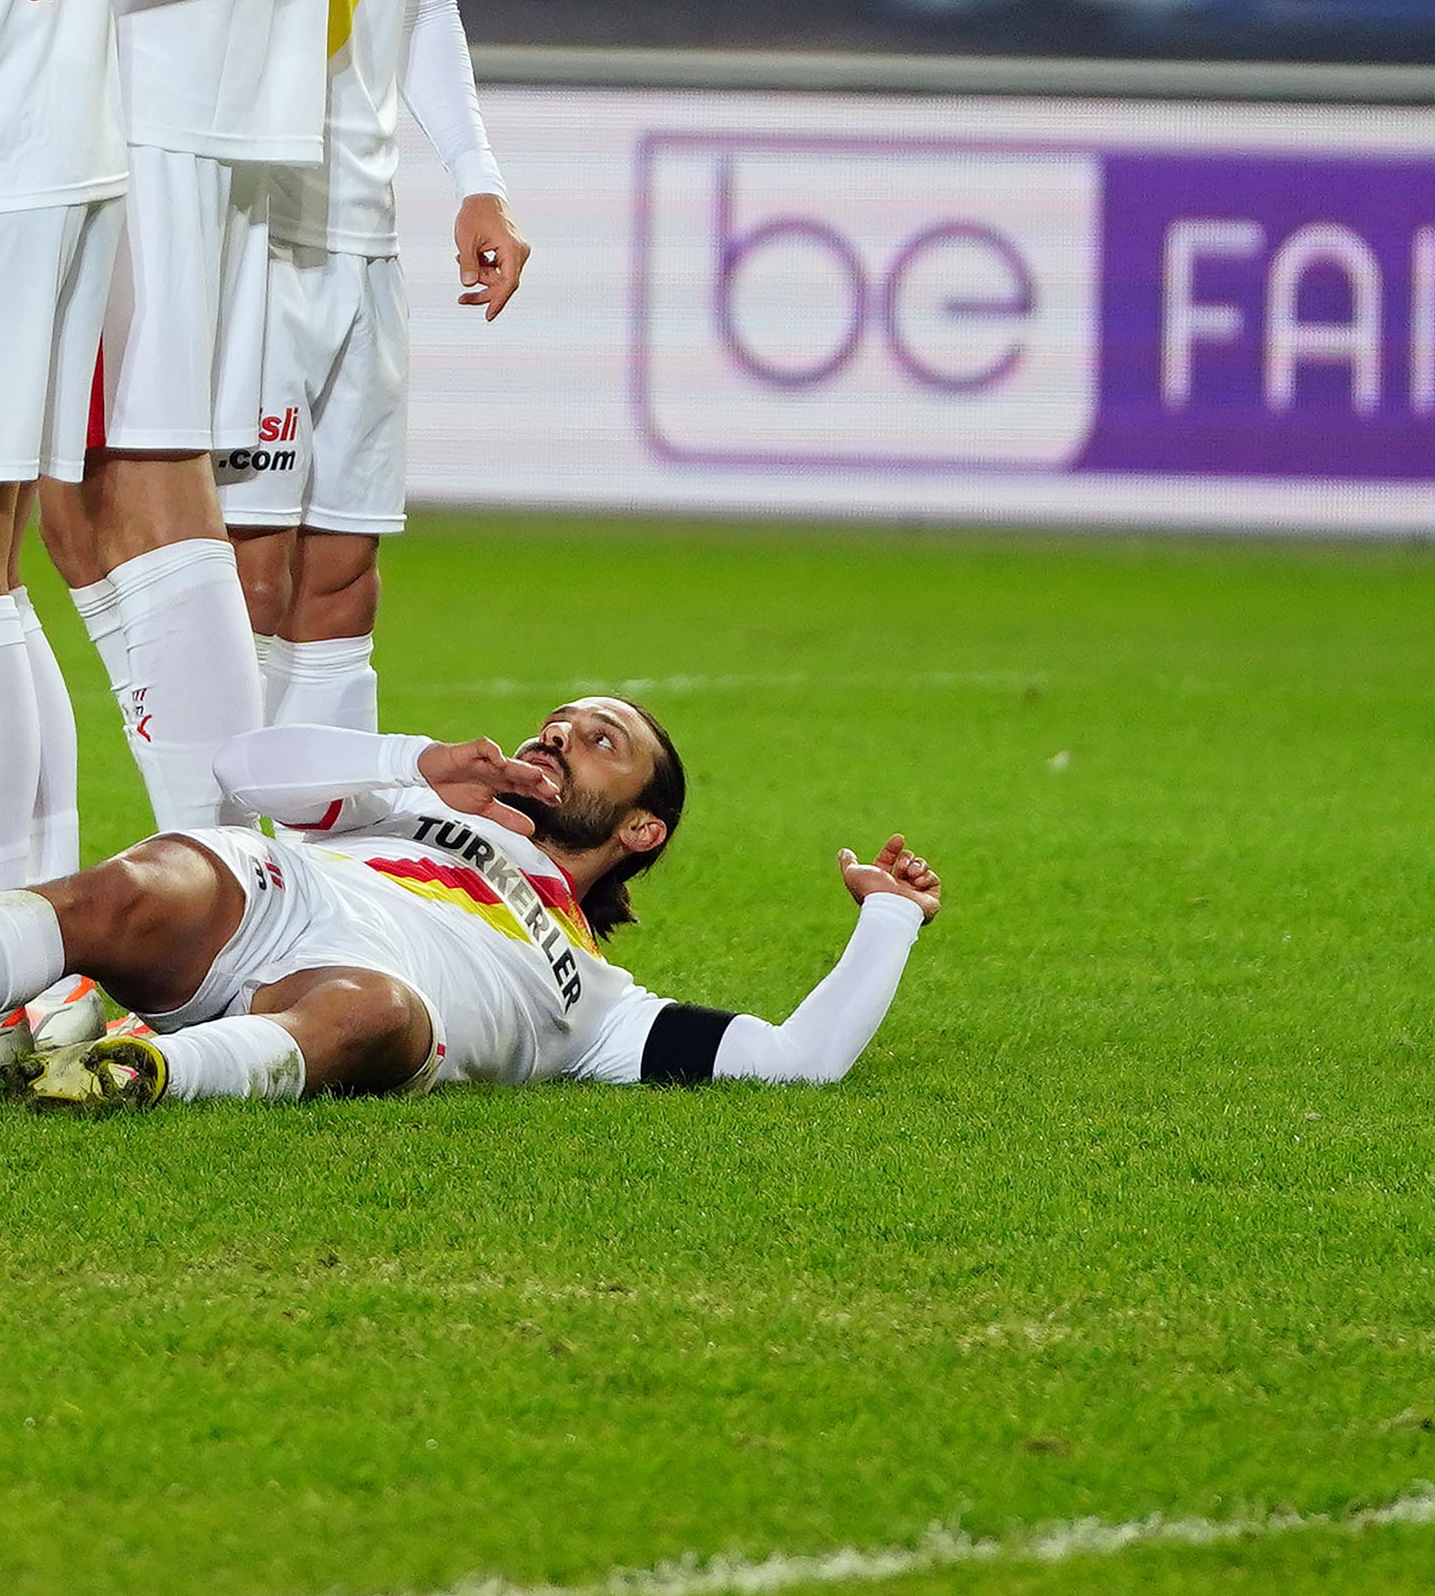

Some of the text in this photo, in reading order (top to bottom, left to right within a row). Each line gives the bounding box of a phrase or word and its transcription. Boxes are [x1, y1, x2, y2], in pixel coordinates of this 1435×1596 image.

[712, 153, 1039, 396] be
[218, 448, 296, 471] .com
[411, 815, 583, 1015] TÜRKERLER
